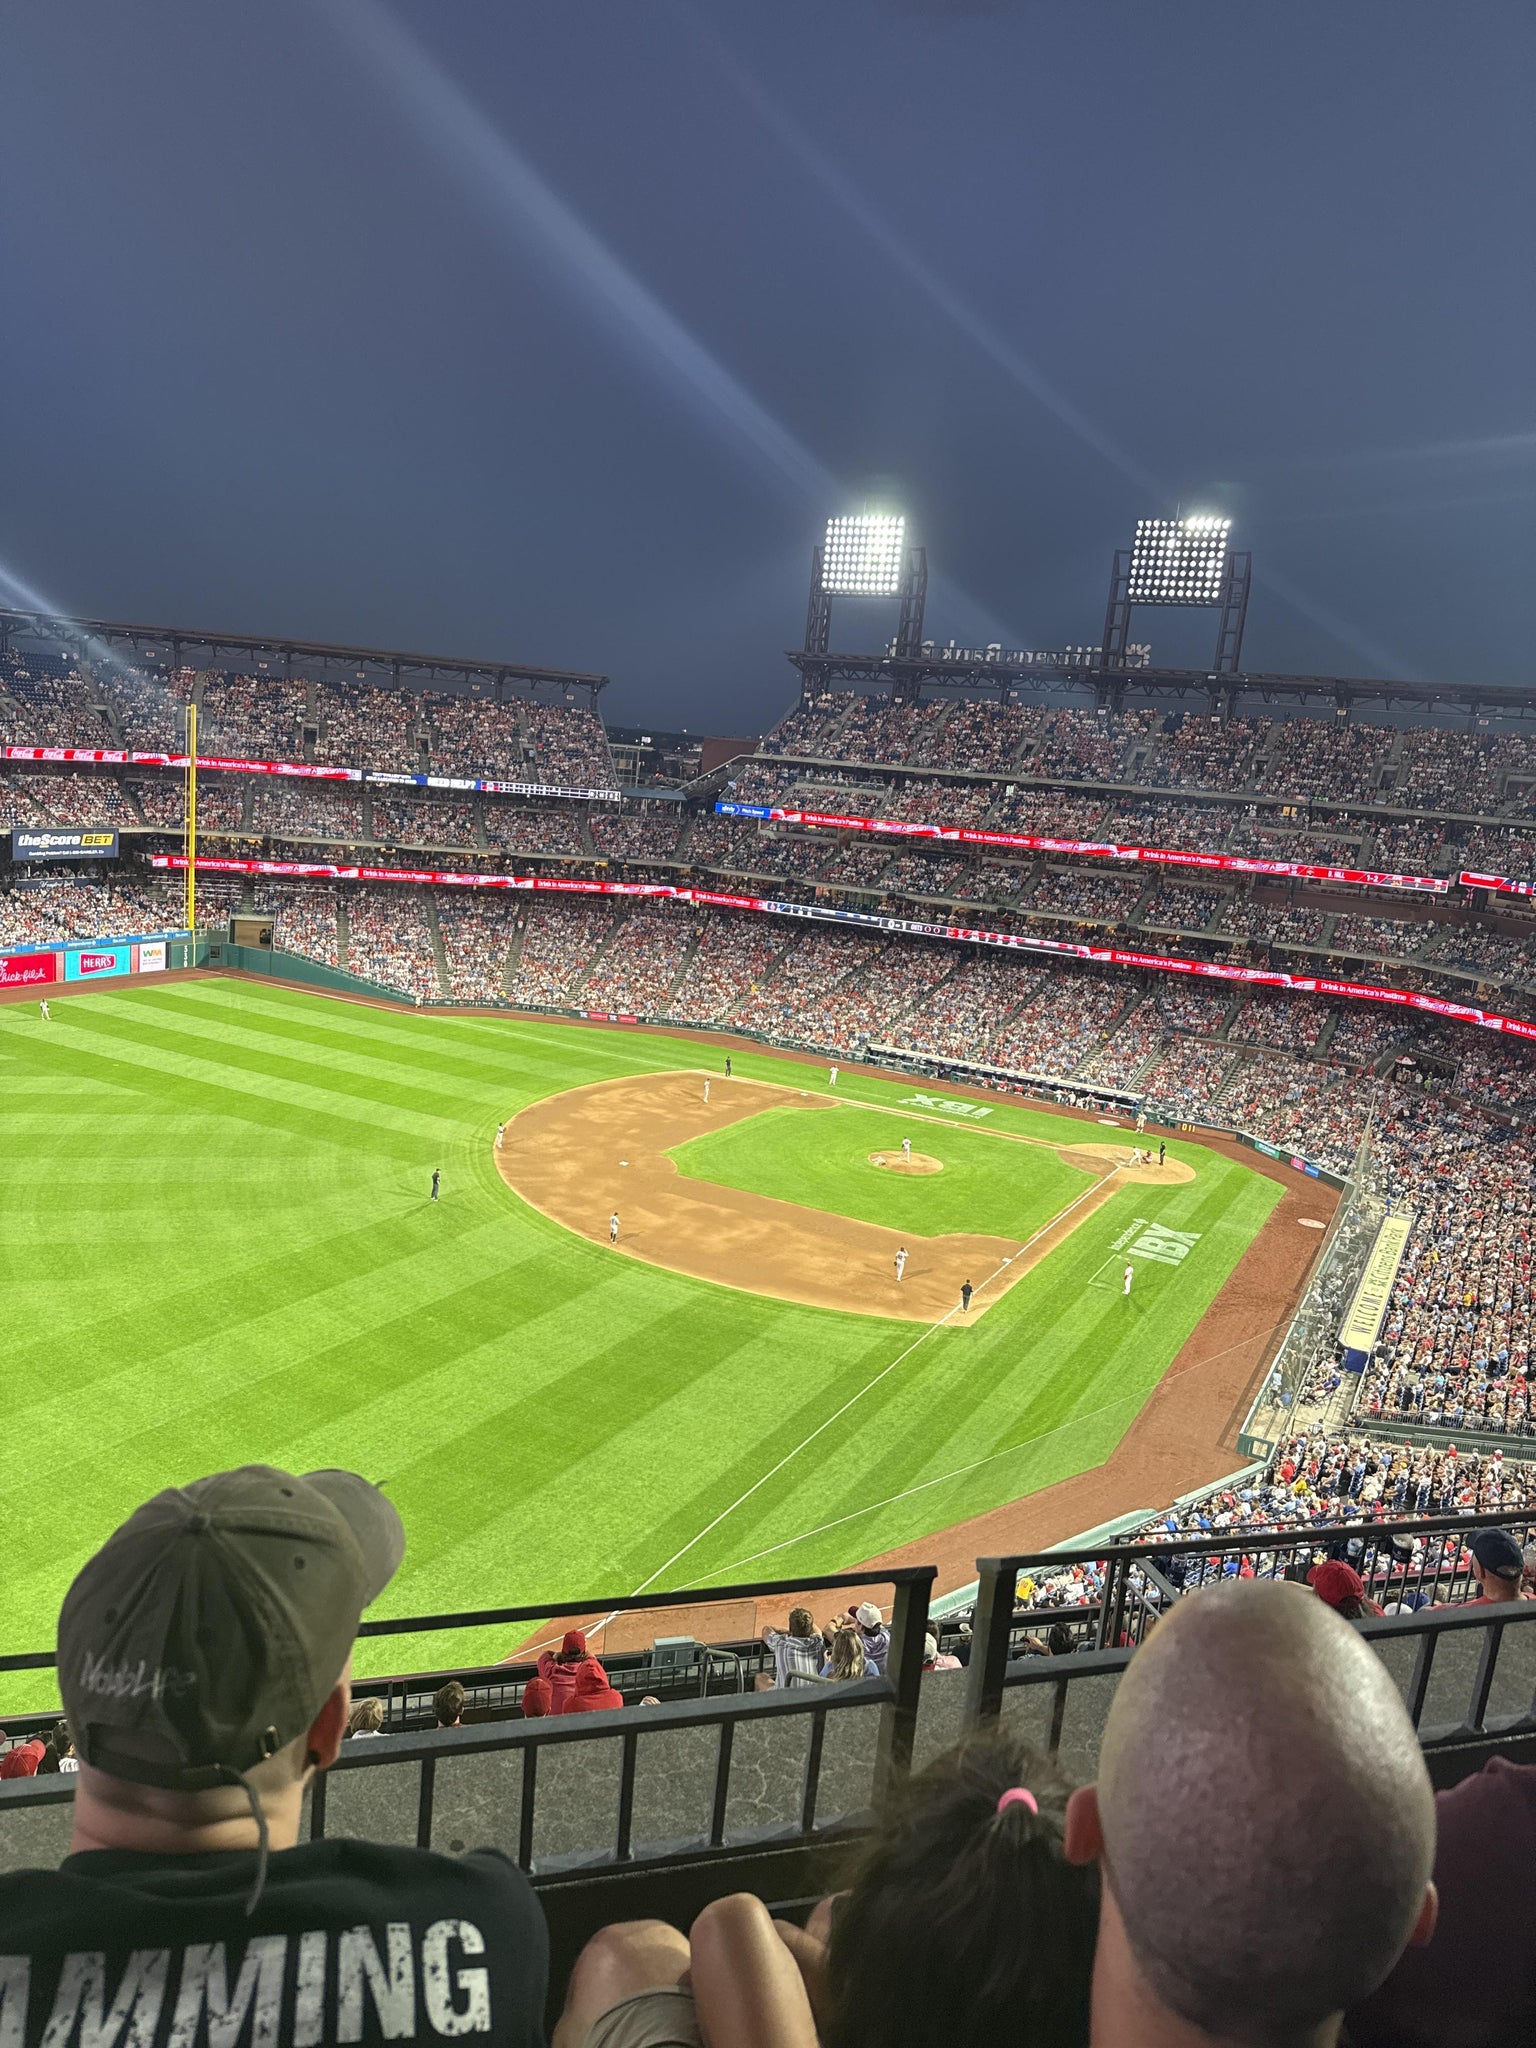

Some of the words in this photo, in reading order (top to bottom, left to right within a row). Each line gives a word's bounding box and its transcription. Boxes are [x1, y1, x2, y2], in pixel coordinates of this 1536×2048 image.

[18, 834, 80, 846] theScore
[84, 835, 111, 844] BET
[83, 957, 112, 968] HERR'S
[1139, 957, 1167, 966] America's
[1168, 960, 1192, 969] Pastime
[1321, 982, 1338, 991] Drink
[1347, 986, 1379, 997] America's
[1380, 990, 1407, 1000] Pastime
[1126, 1222, 1203, 1266] IBX
[1377, 1239, 1400, 1256] Bank
[1369, 1252, 1395, 1281] Citizens
[1349, 1290, 1383, 1336] WELCOME
[0, 1919, 491, 2048] MMING
